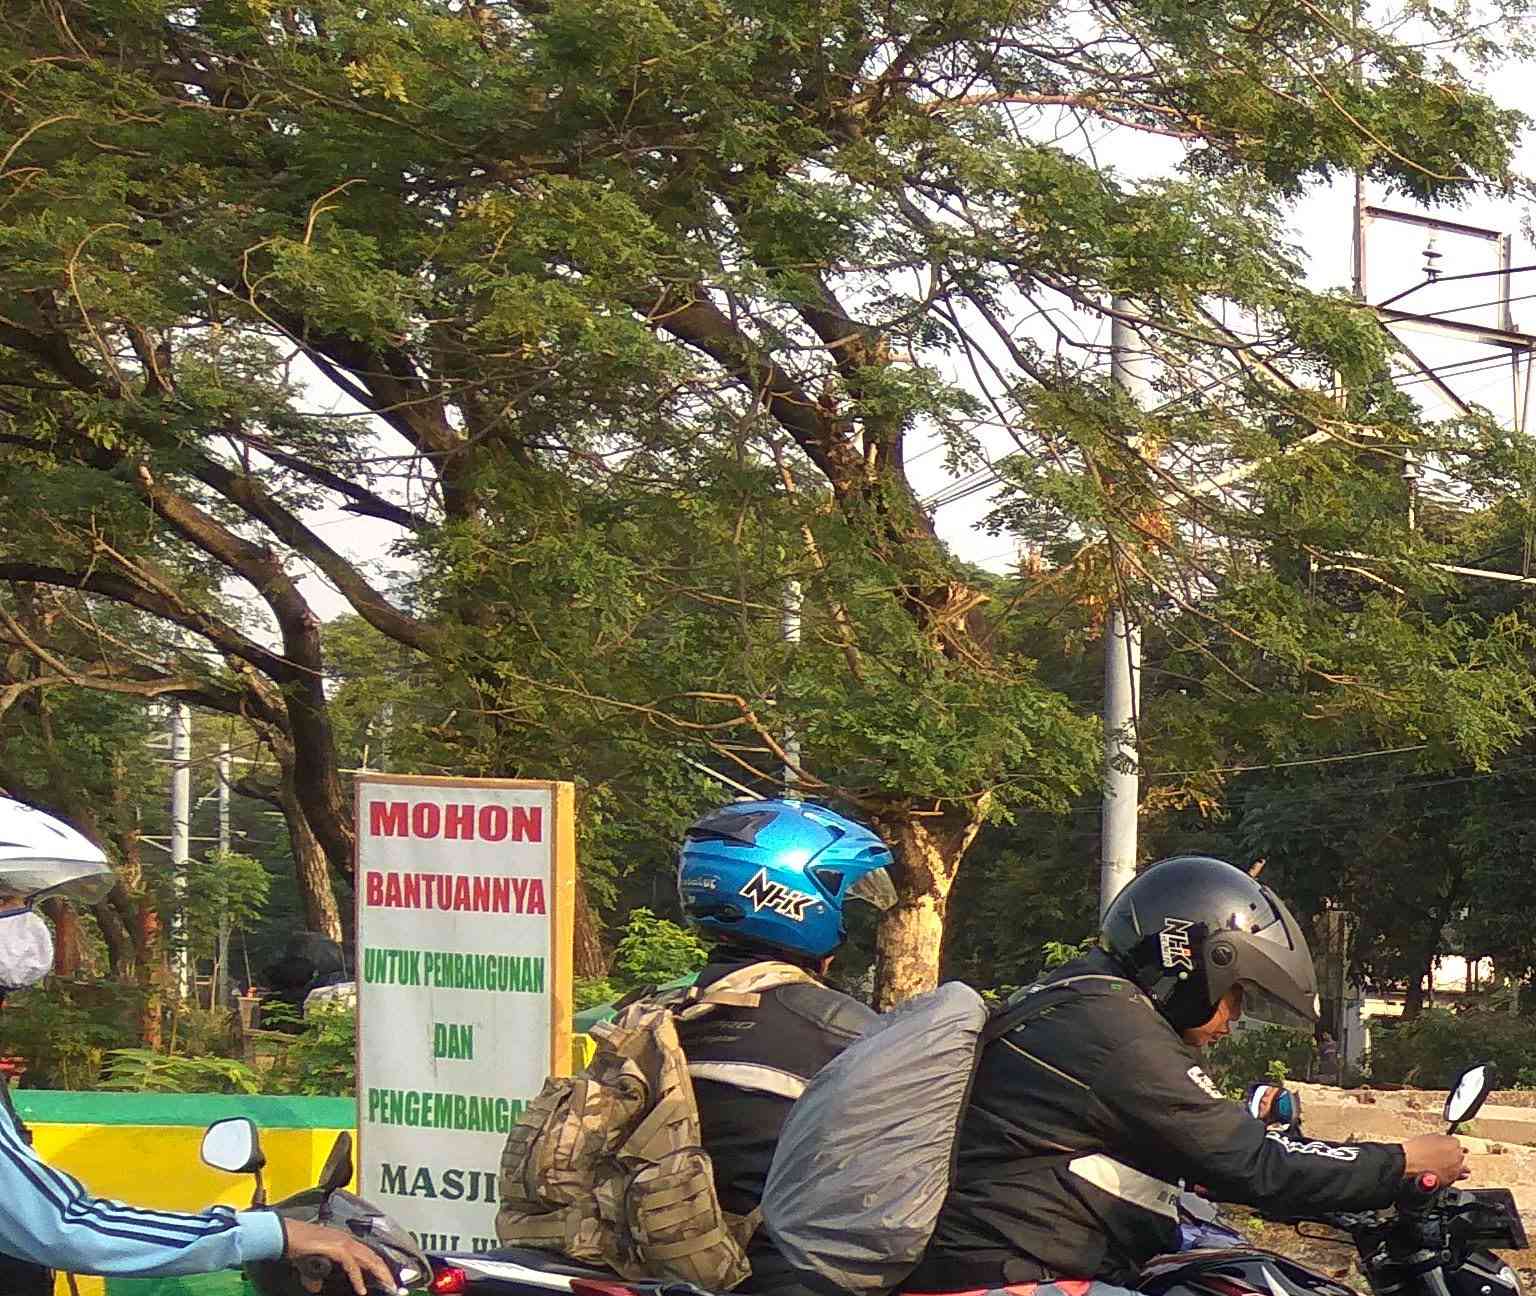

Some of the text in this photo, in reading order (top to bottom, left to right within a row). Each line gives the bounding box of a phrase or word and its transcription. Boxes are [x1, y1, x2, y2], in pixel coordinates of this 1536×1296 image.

[370, 802, 542, 842] MOHON
[366, 871, 546, 915] BANTUANNYA
[739, 867, 817, 922] NHK
[364, 948, 544, 993] UNTUK PEMBANGUNAN
[434, 1022, 473, 1060] DAN
[368, 1087, 528, 1134] PENGEMBANGA
